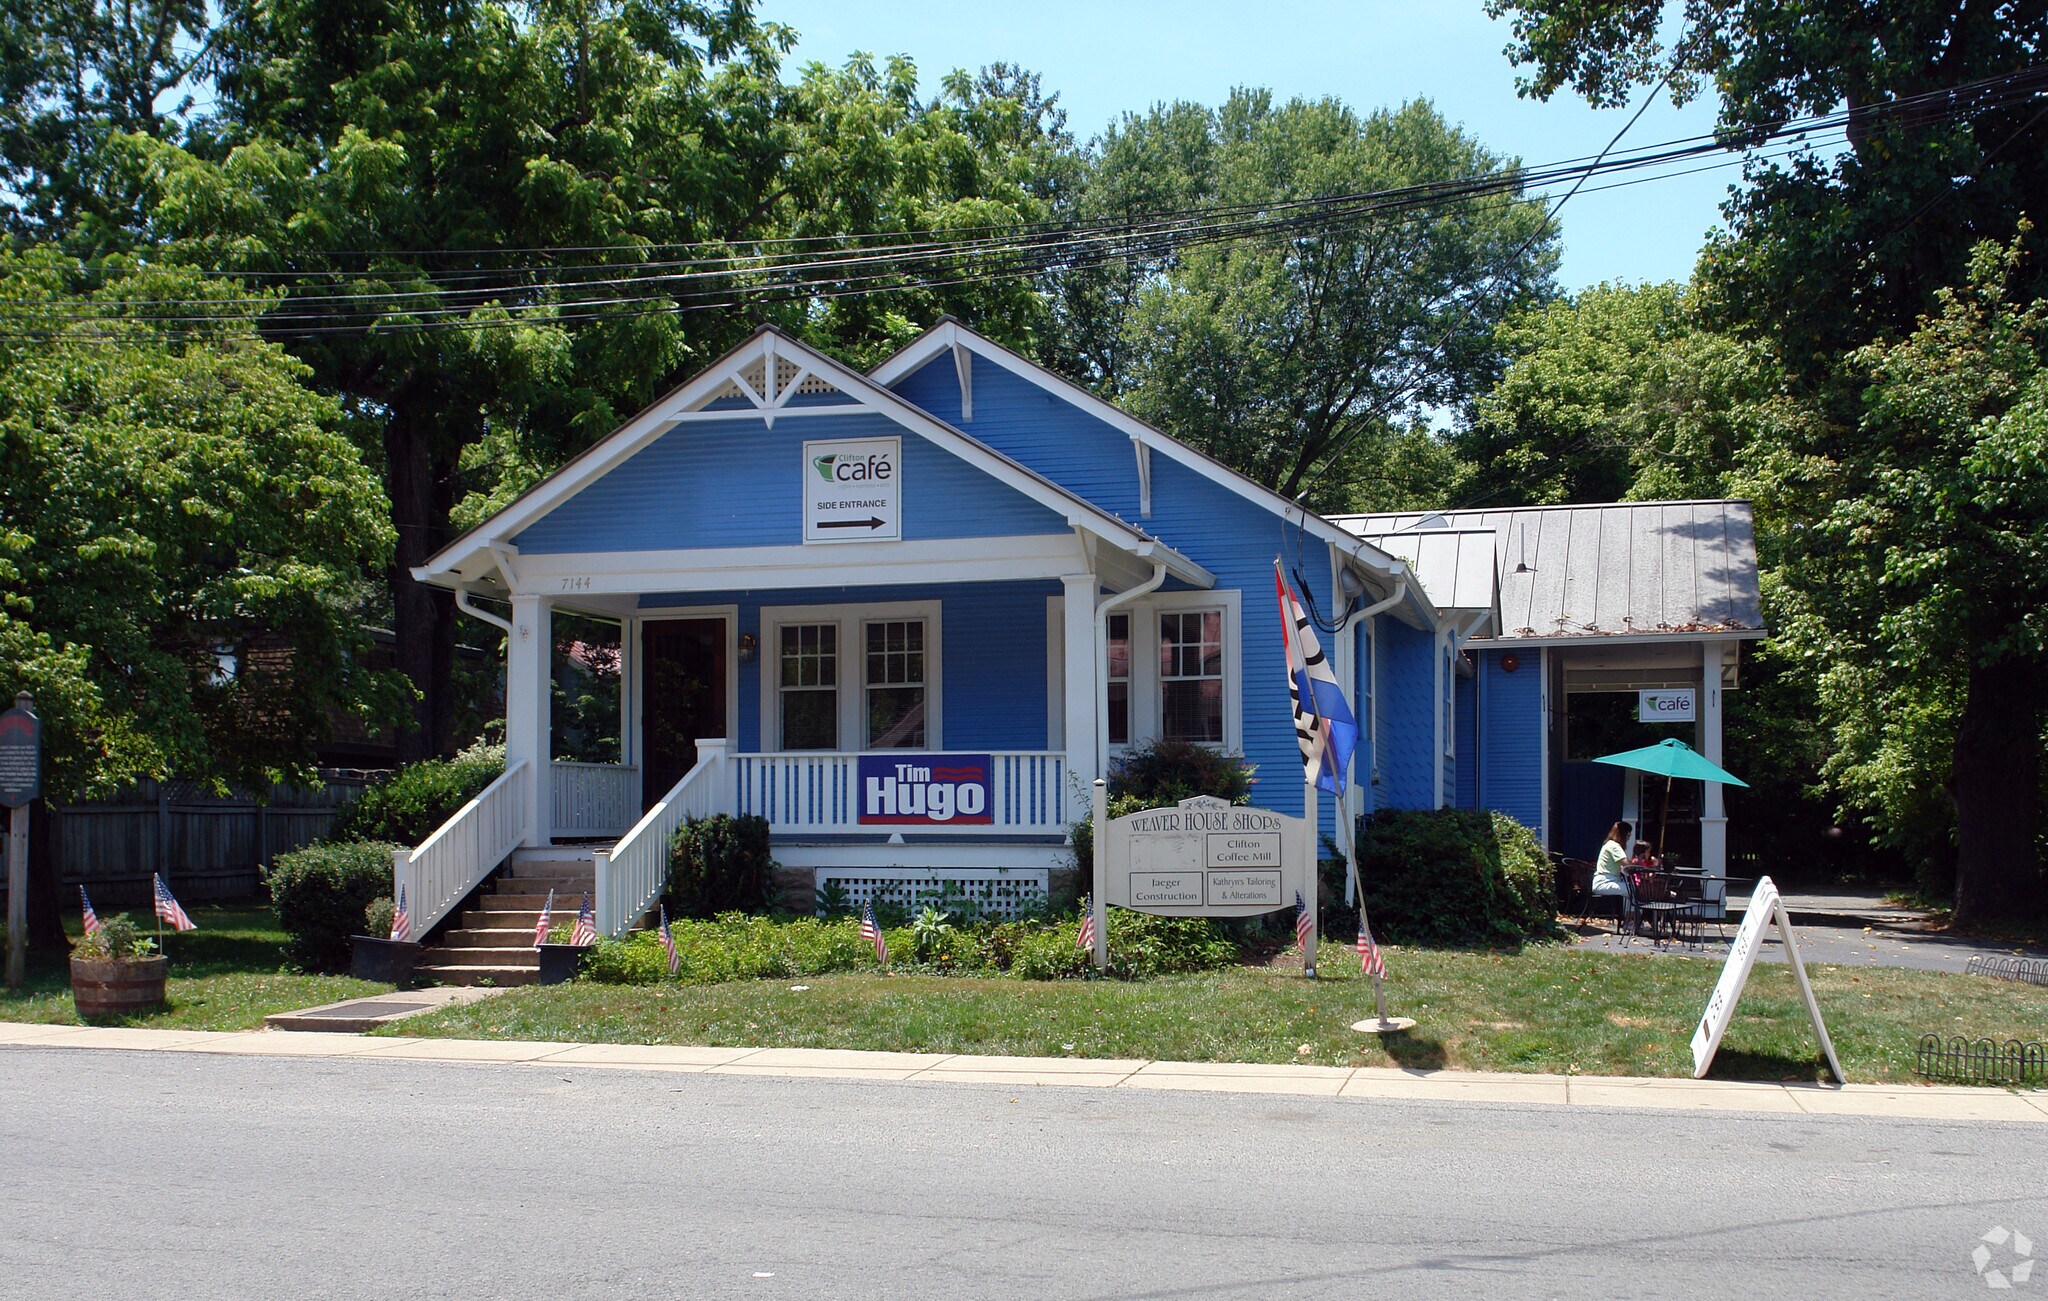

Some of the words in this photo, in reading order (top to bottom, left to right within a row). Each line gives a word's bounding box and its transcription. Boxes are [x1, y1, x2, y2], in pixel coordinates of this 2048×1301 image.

[838, 454, 865, 462] Clifton
[836, 453, 892, 481] café
[817, 501, 837, 510] SIDE
[839, 499, 887, 509] ENTRANCE
[562, 576, 591, 591] 7144
[1658, 696, 1690, 711] café
[895, 764, 931, 782] Tim
[866, 776, 985, 821] Hugo
[1131, 813, 1180, 832] WEAVER
[1184, 812, 1228, 831] HOUSE
[1232, 813, 1282, 831] SHOPS
[1227, 840, 1260, 849] Clifton
[1216, 853, 1250, 862] Coffee
[1252, 852, 1272, 861] Mill
[1151, 878, 1181, 889] Jaeger
[1247, 877, 1276, 889] Tailoring
[1136, 892, 1198, 901] Construction
[1221, 891, 1228, 900] &
[1230, 891, 1267, 900] Alterations
